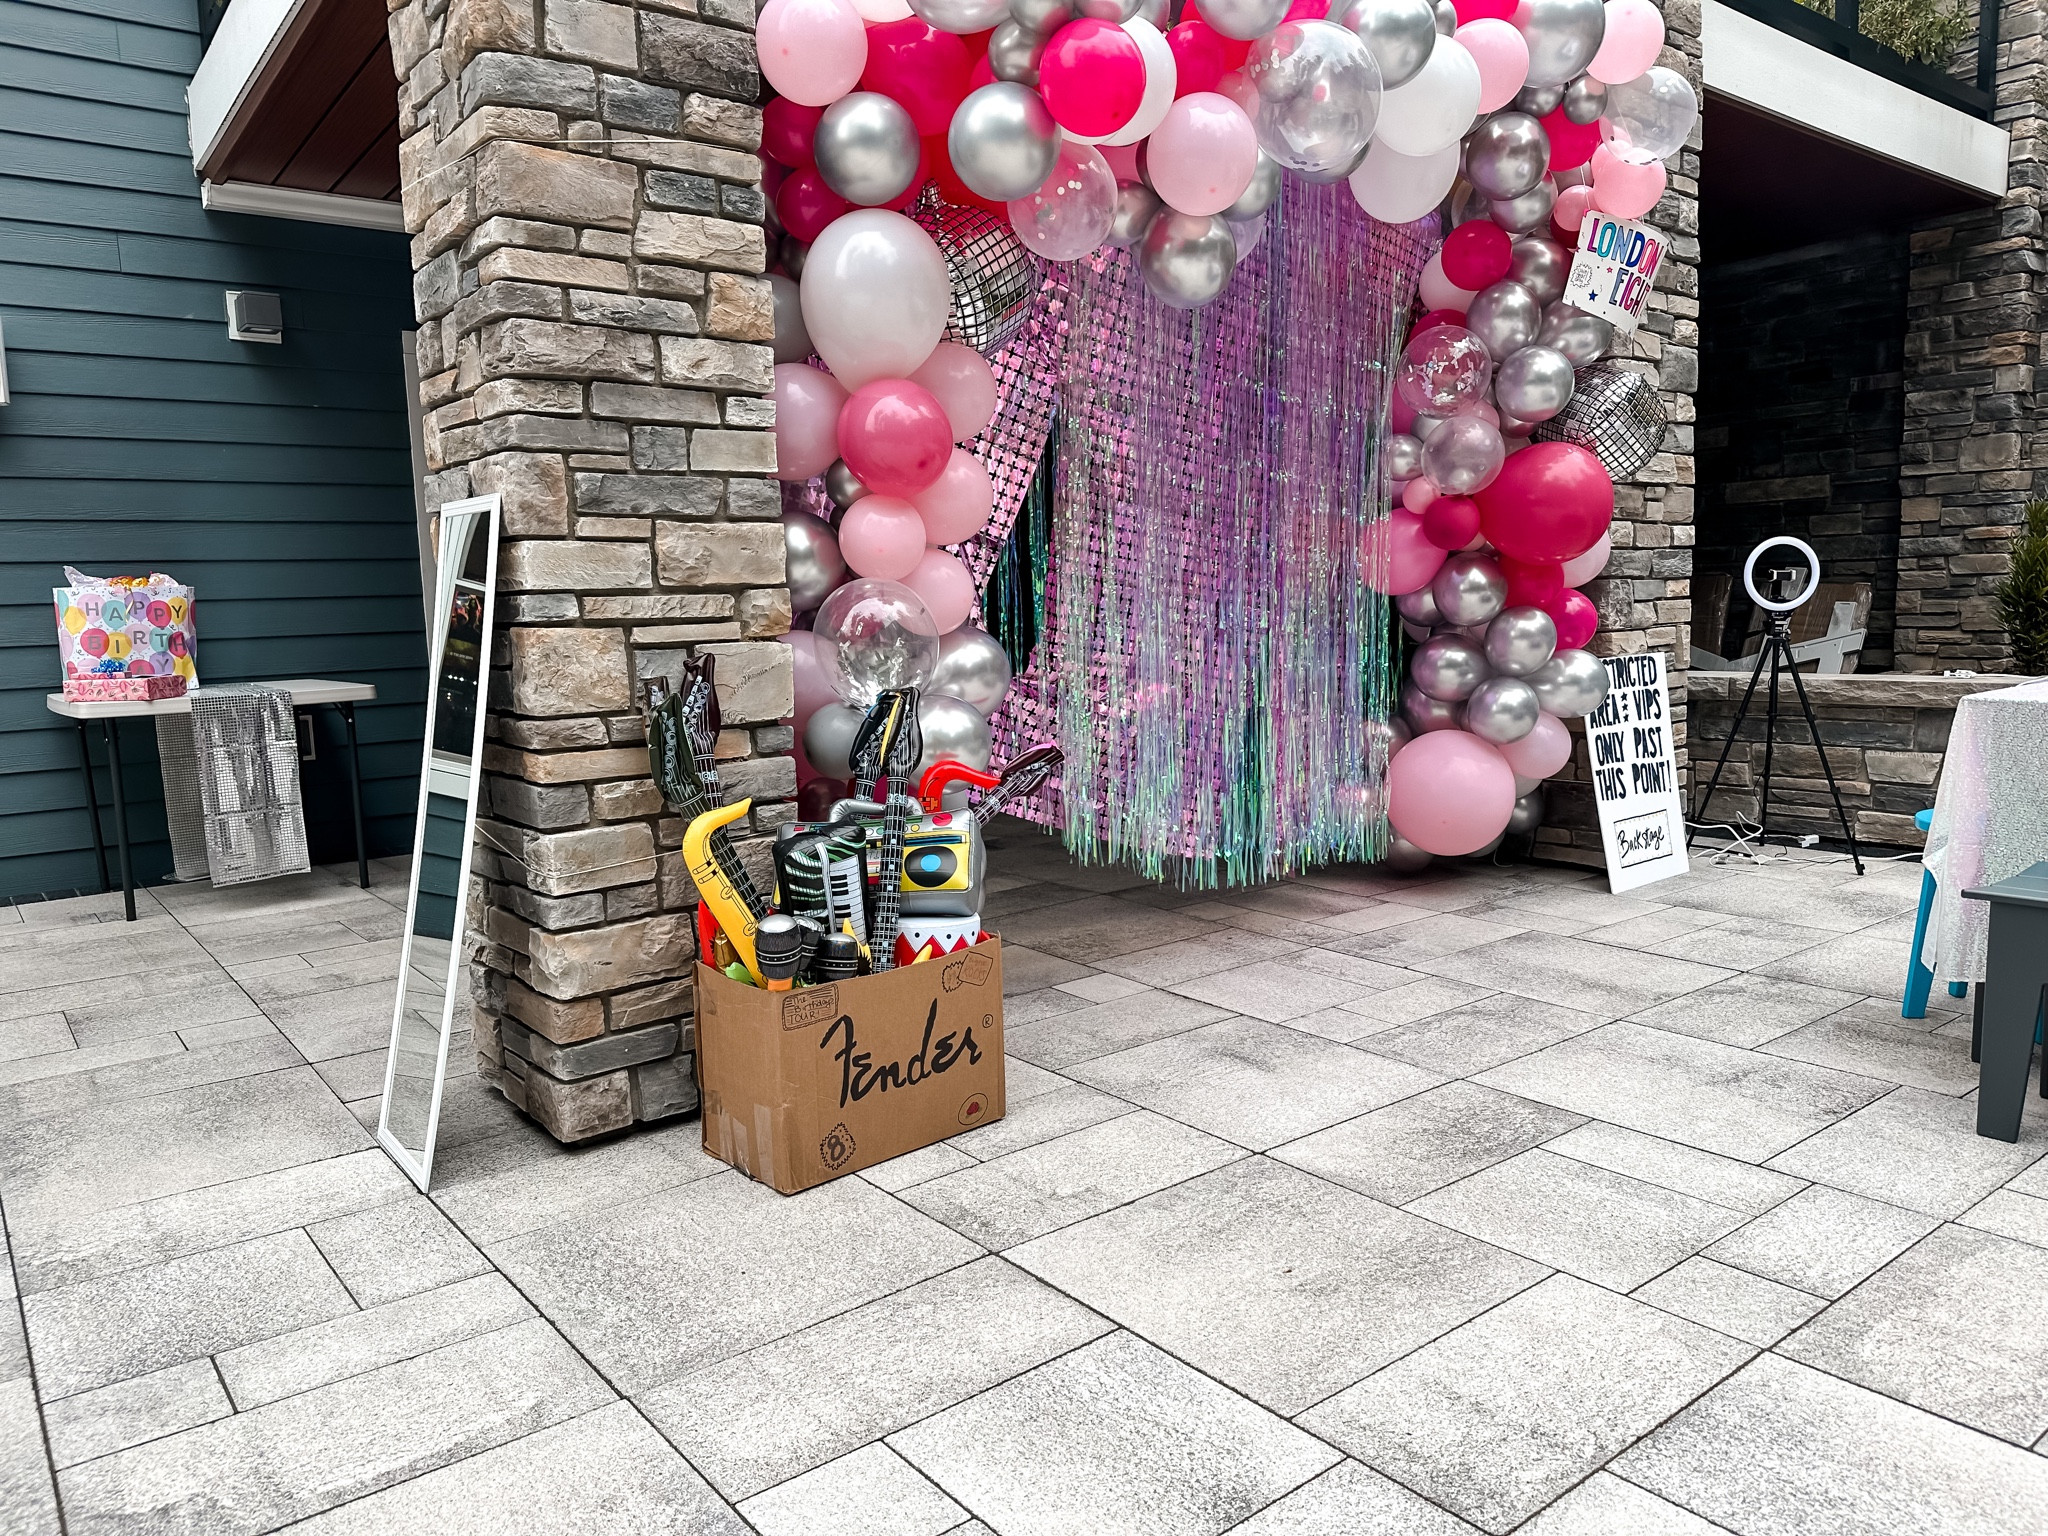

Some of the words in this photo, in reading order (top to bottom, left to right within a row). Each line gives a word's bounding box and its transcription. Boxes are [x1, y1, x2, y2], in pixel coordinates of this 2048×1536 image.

[1587, 218, 1664, 280] LONDON
[85, 602, 182, 621] HAPPY
[87, 631, 186, 653] BIRTH
[1633, 688, 1662, 721] VIPS
[1595, 731, 1625, 766] ONLY
[1633, 727, 1663, 759] PAST
[1595, 767, 1627, 801] THIS
[1632, 760, 1672, 794] POINT!
[820, 998, 982, 1108] Fender
[827, 1135, 846, 1162] 8
